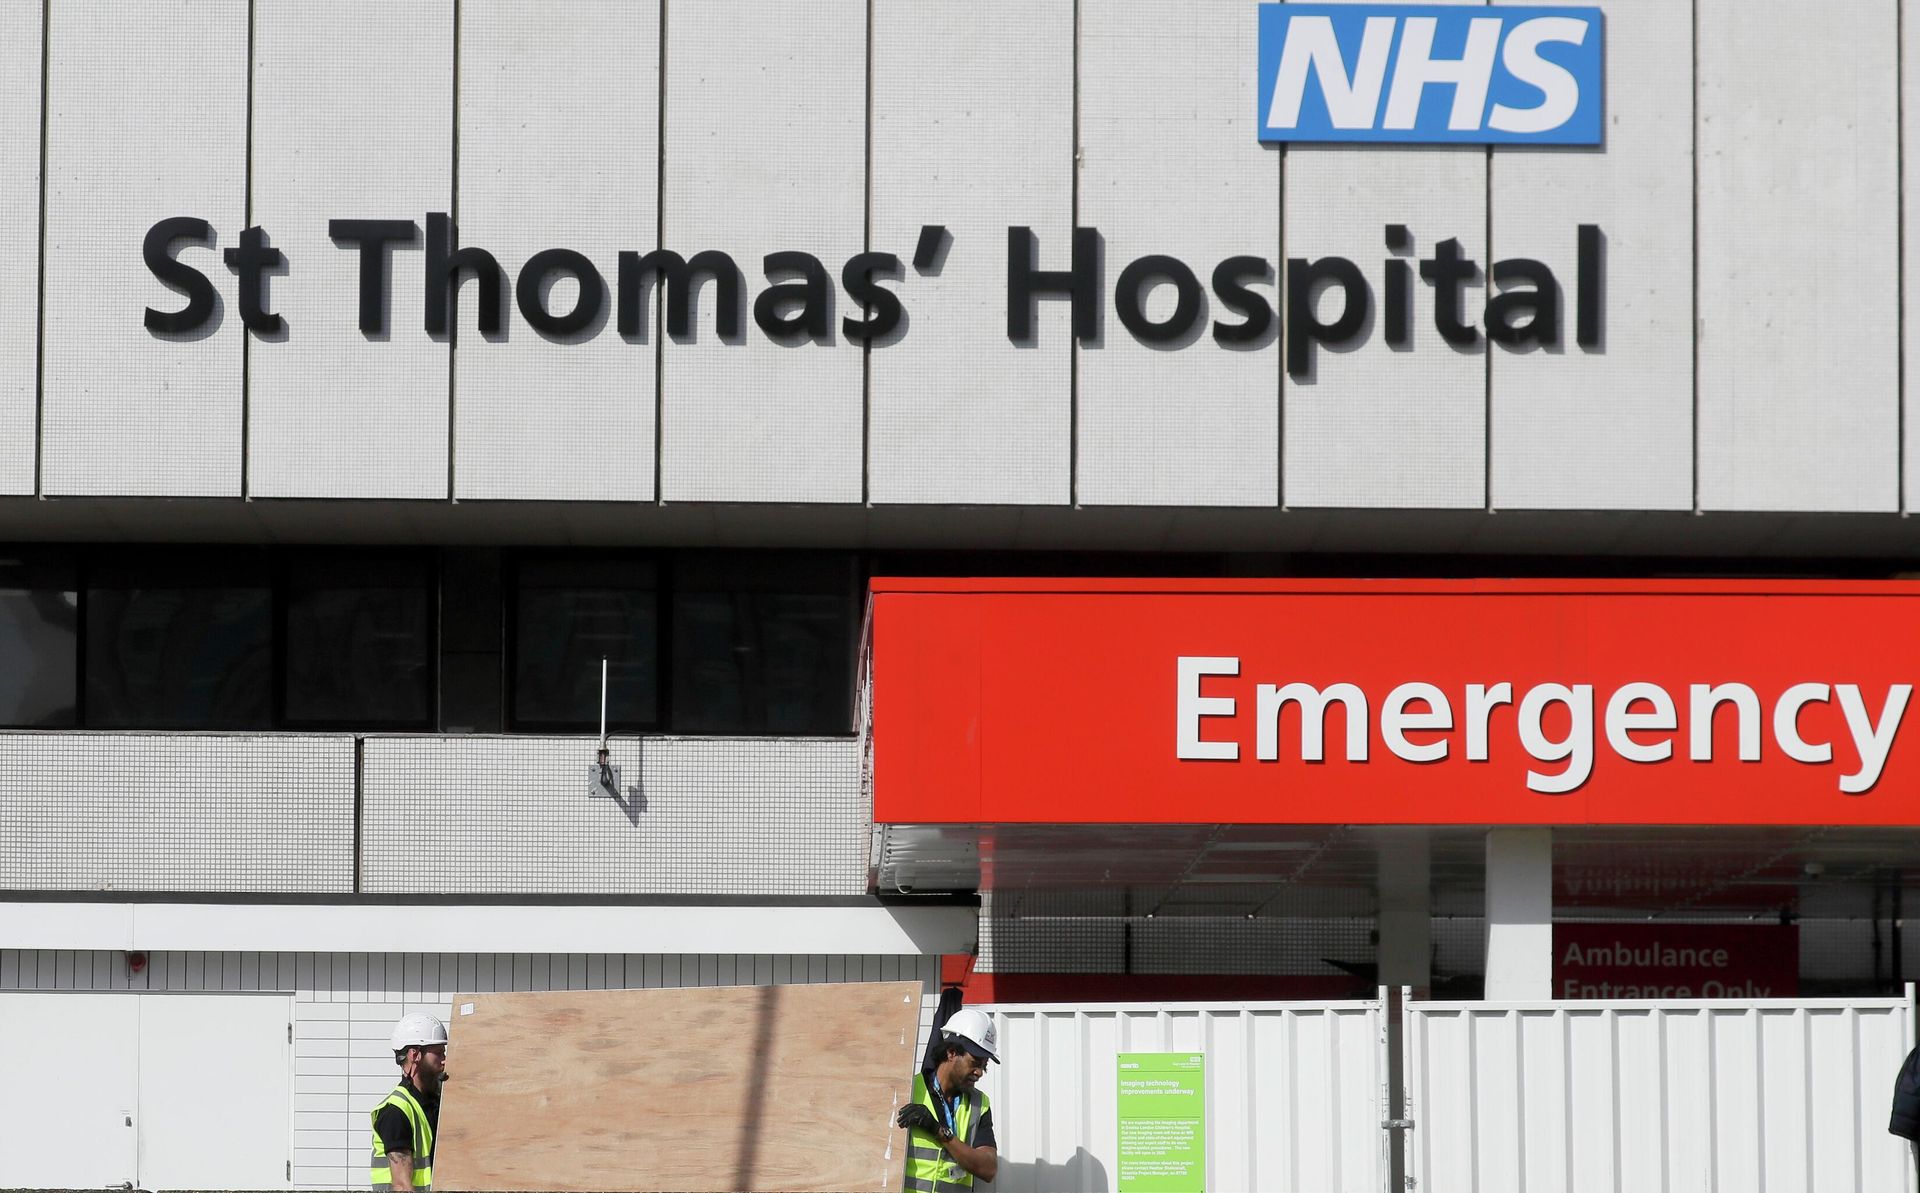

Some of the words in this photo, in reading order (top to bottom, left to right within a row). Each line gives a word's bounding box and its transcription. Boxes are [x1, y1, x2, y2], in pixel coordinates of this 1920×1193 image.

[1268, 17, 1588, 132] NHS
[143, 217, 282, 337] St
[1008, 225, 1601, 377] Hospital
[1176, 656, 1913, 793] Emergency
[1563, 942, 1728, 966] Ambulance
[1564, 980, 1692, 999] Entrance
